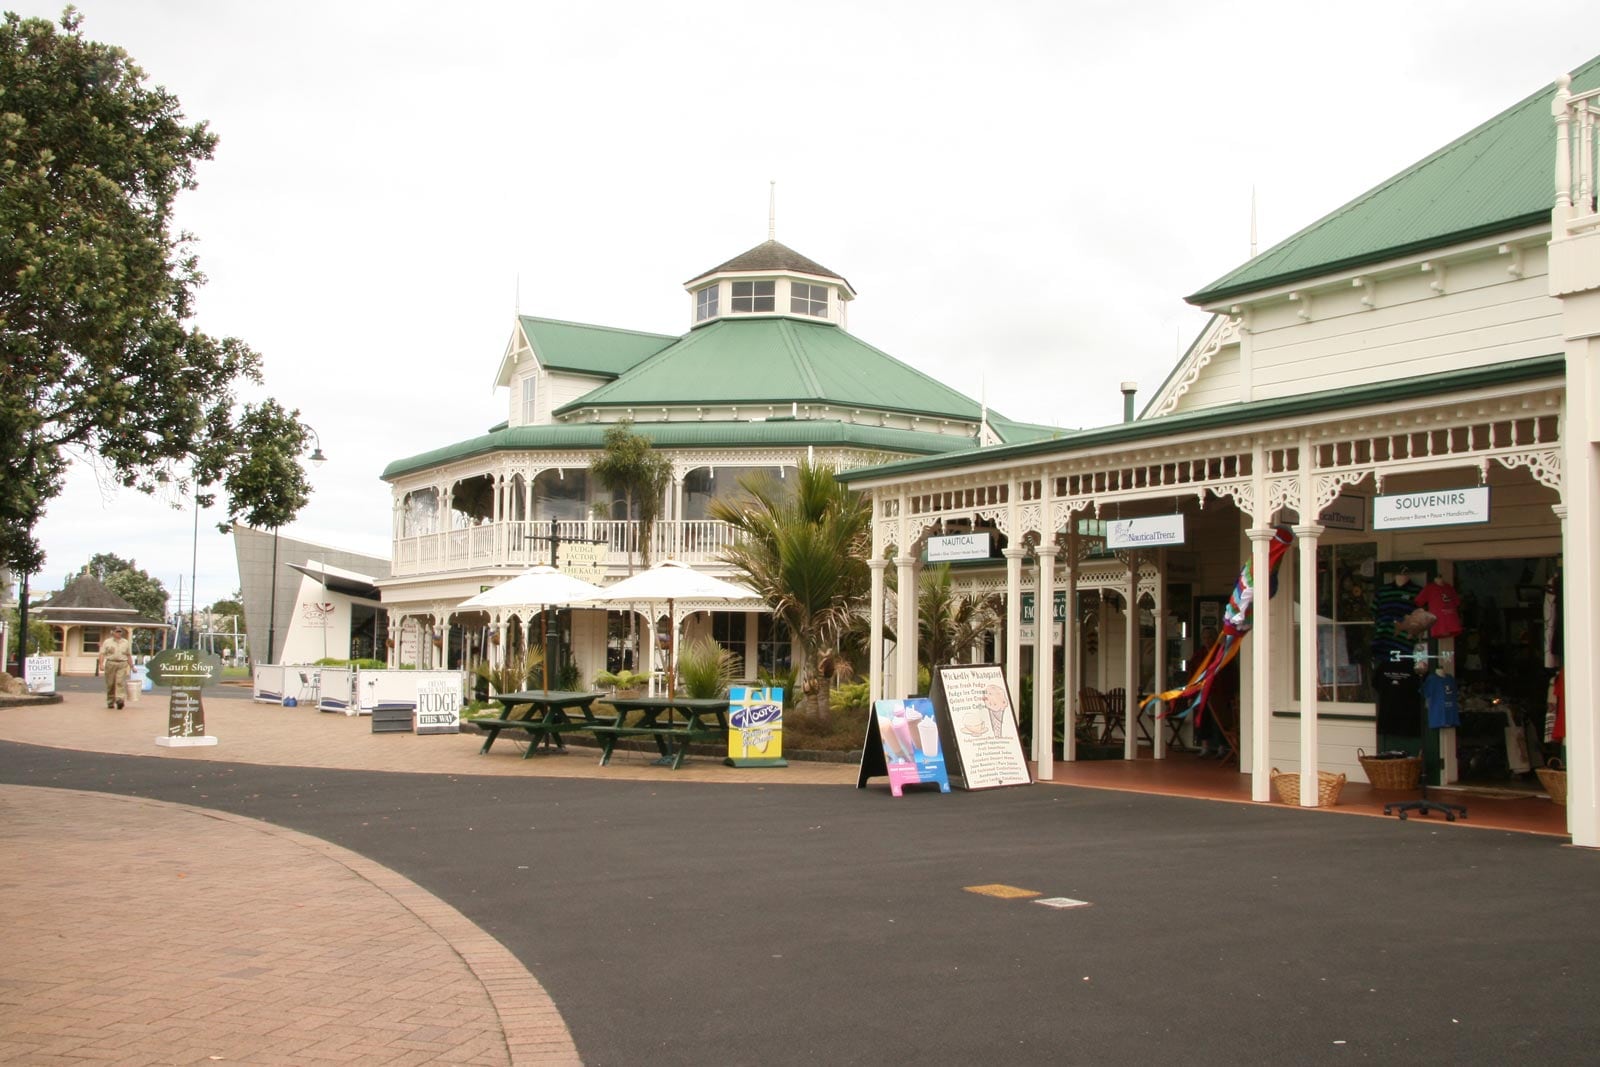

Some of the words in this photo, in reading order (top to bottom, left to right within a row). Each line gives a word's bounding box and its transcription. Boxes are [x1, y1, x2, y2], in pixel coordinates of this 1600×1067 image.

[1395, 492, 1465, 510] SOUVENIRS
[942, 536, 974, 546] NAUTICAL
[1128, 531, 1176, 542] NauticalTrenz
[570, 545, 593, 553] FUDGE
[566, 553, 598, 561] FACTORY
[579, 567, 601, 576] KAURI
[175, 651, 195, 661] The
[160, 662, 189, 671] Kauri
[191, 662, 214, 673] Shop
[419, 693, 458, 712] FUDGE
[421, 715, 438, 723] THIS
[438, 713, 454, 723] WAY
